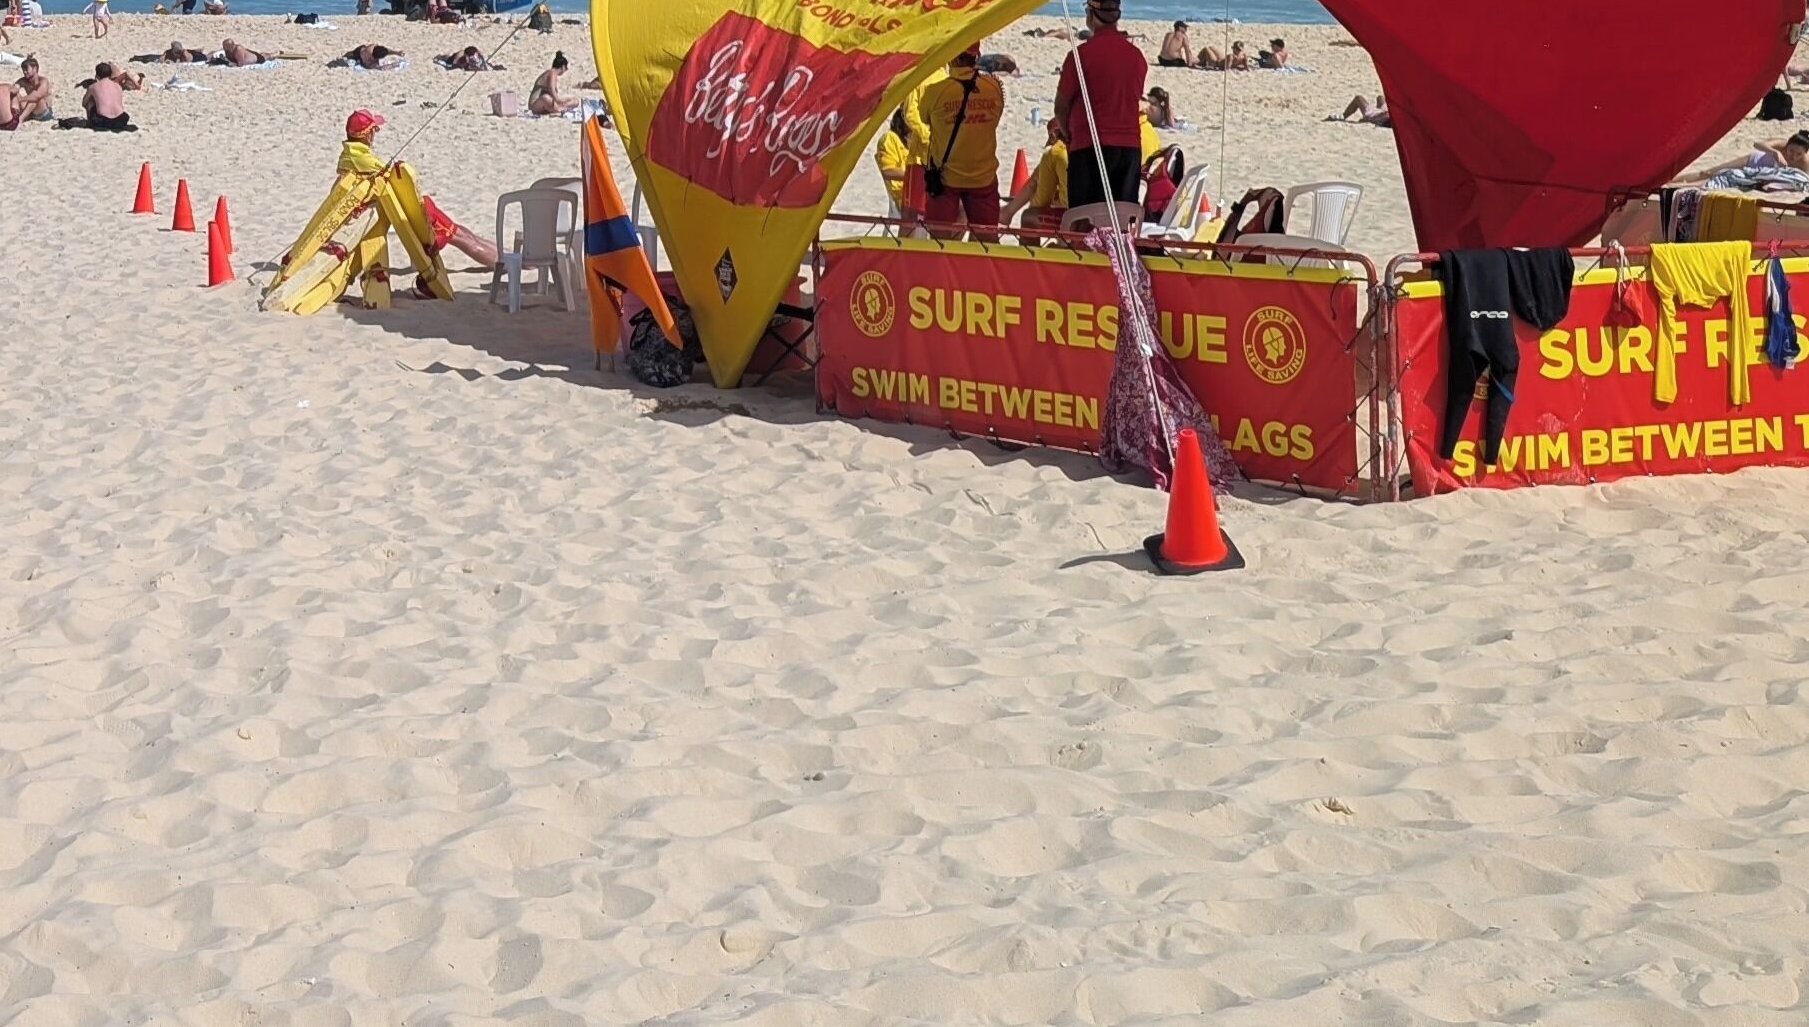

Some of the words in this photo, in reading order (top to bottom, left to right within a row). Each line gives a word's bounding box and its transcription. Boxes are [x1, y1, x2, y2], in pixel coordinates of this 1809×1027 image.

[337, 195, 360, 218] BONDI
[908, 286, 1022, 338] SURF
[1036, 298, 1228, 364] RESUE
[1257, 309, 1293, 324] SURF
[1470, 311, 1509, 319] orca
[1245, 343, 1265, 375] LIFE
[1267, 348, 1304, 381] SAVING
[851, 367, 930, 405] SWIM
[939, 376, 1099, 429] BETWEEN
[1581, 416, 1784, 466] BETWEEN
